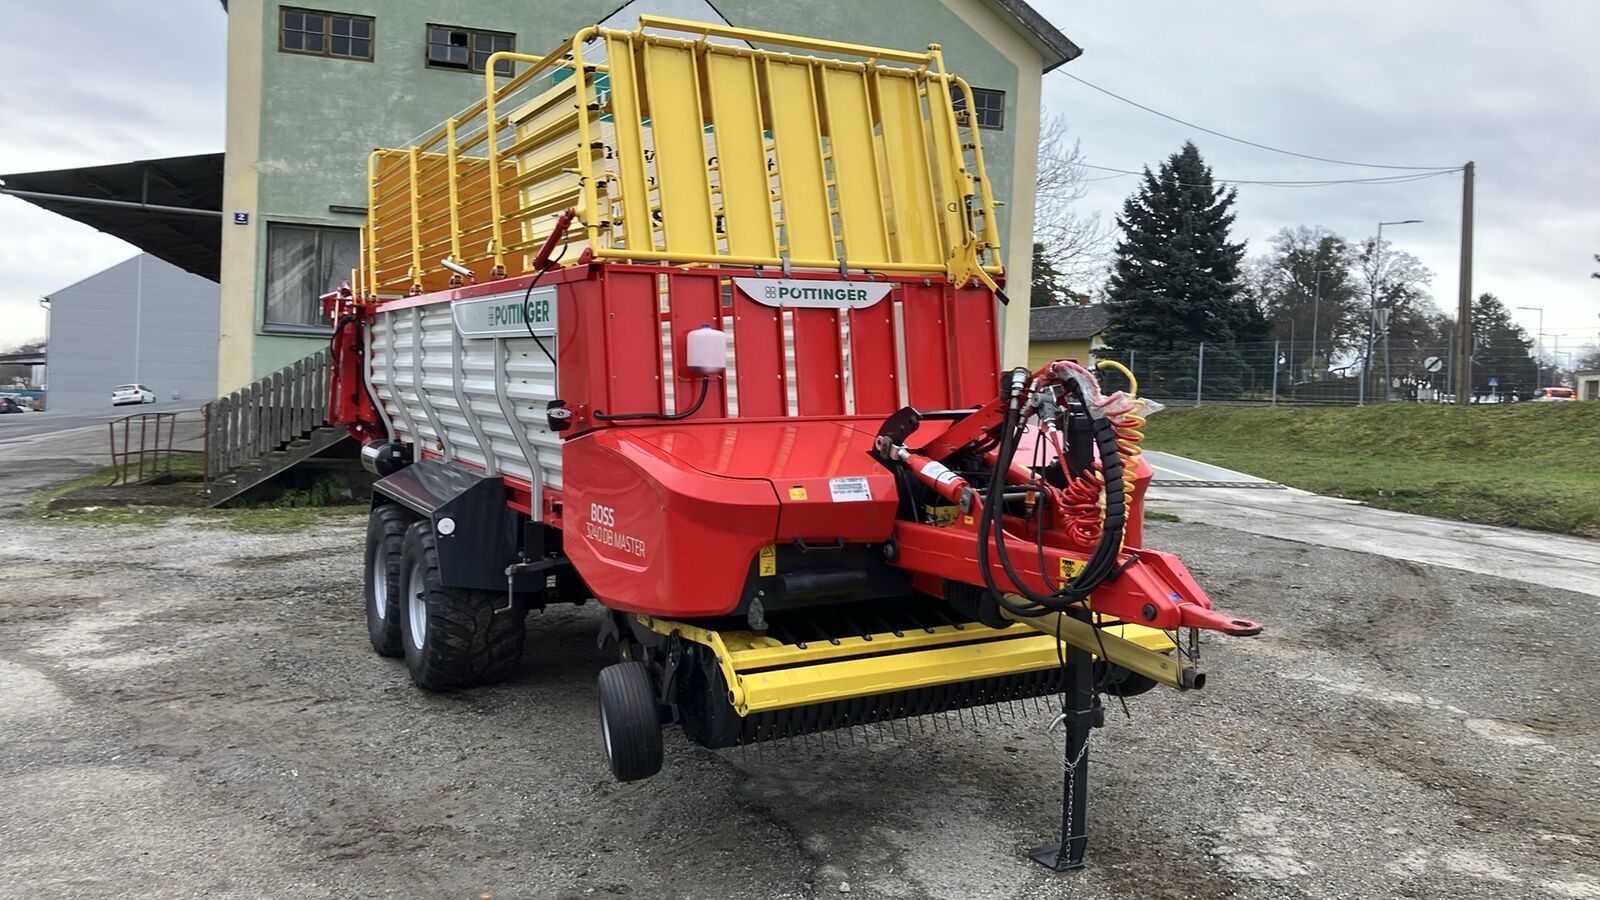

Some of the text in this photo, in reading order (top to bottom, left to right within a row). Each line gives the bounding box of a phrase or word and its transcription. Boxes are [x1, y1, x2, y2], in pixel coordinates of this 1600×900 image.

[237, 213, 246, 221] 2
[591, 502, 615, 528] BOSS
[603, 528, 614, 546] DB
[614, 532, 647, 558] MASTER
